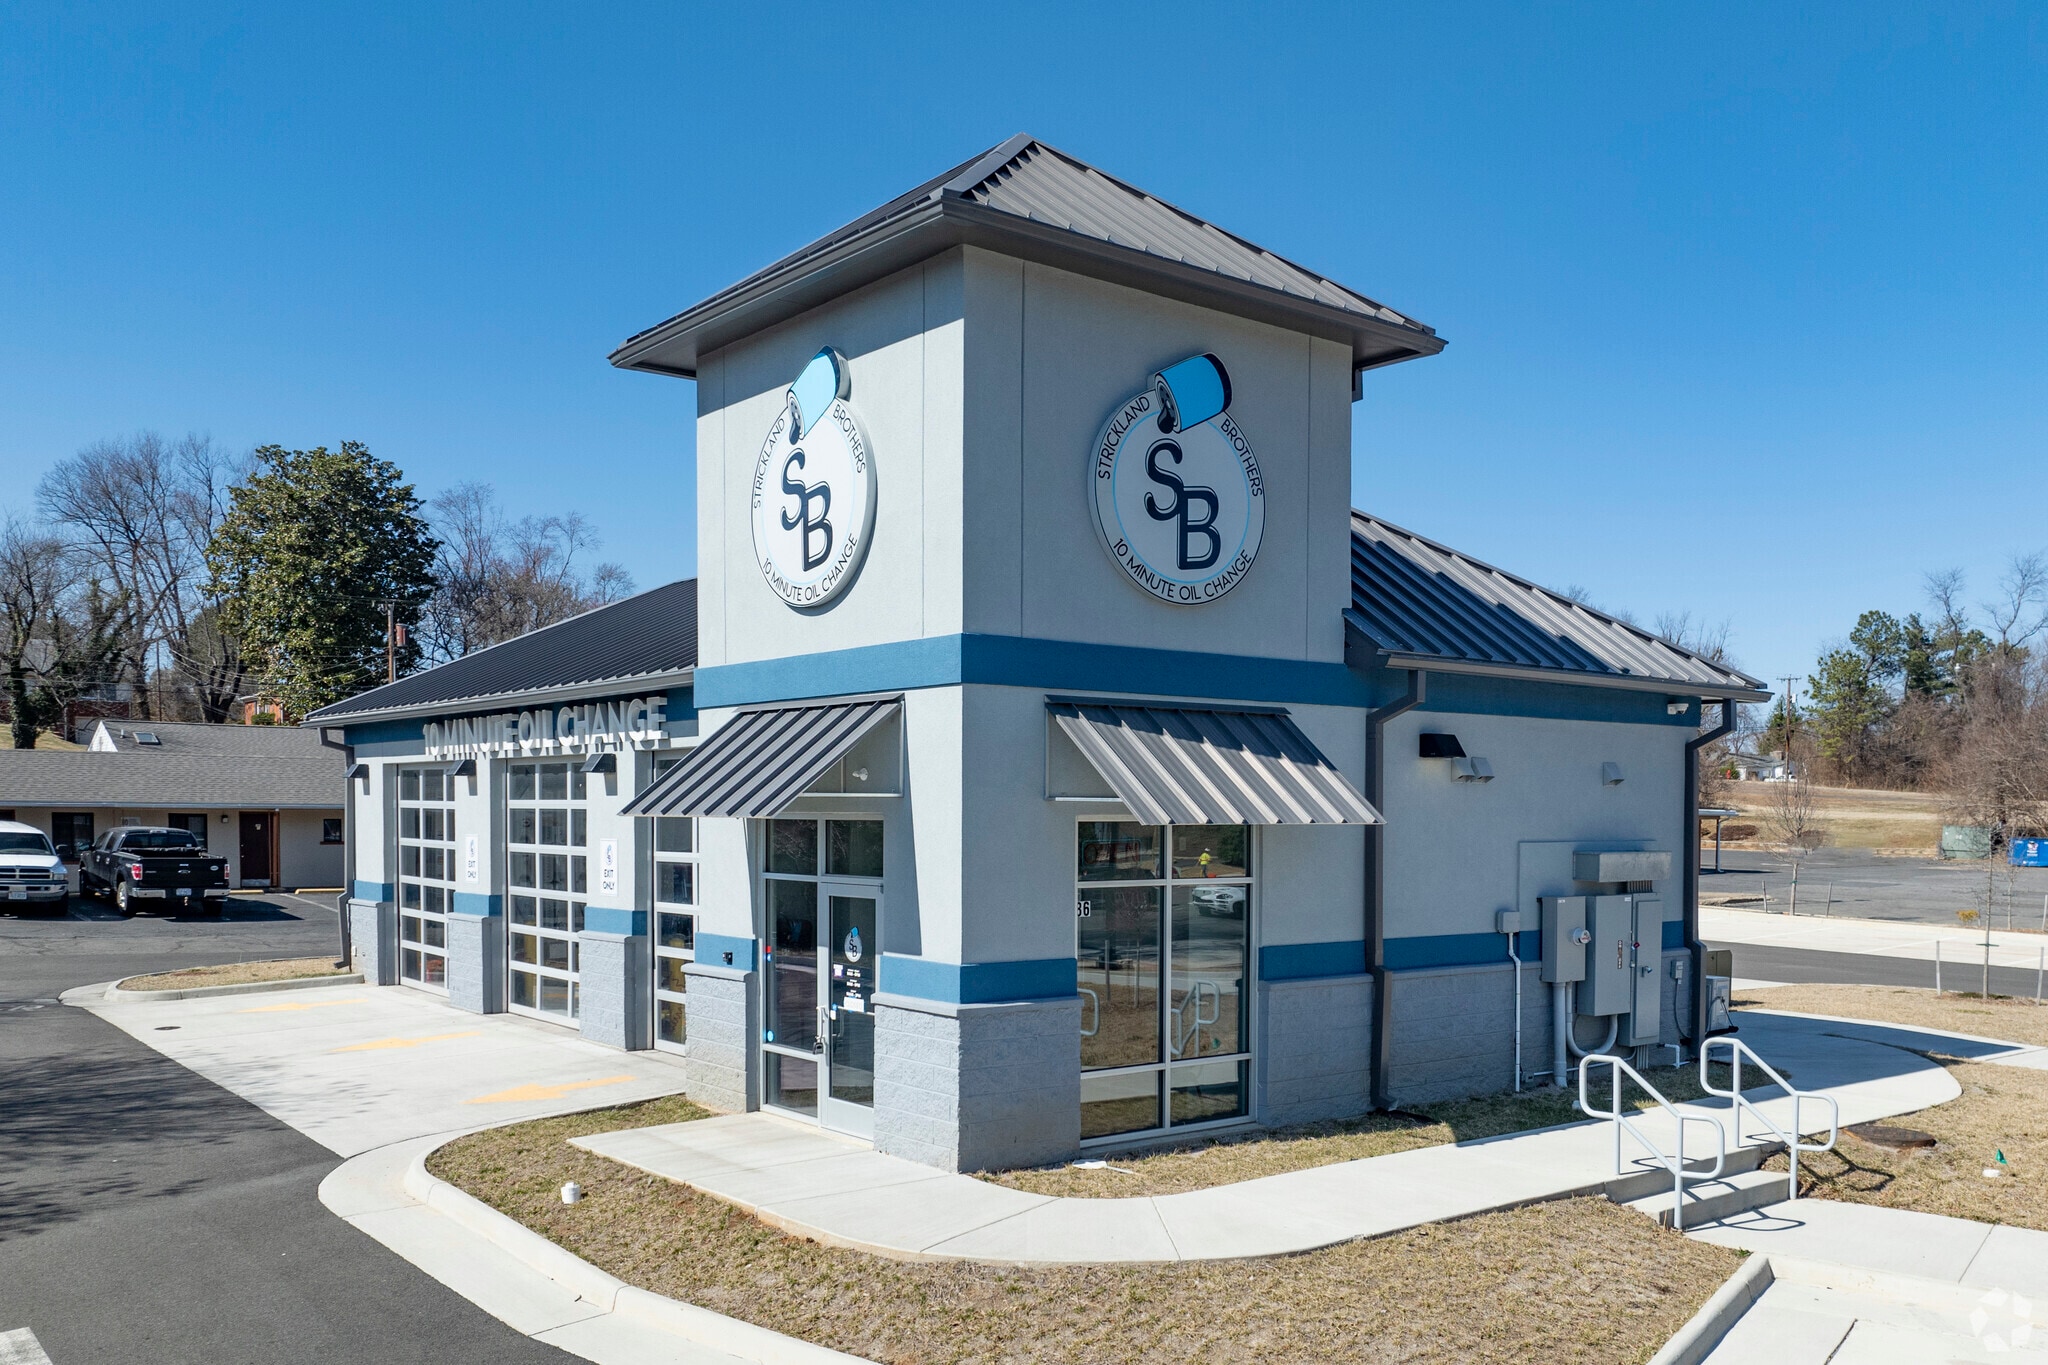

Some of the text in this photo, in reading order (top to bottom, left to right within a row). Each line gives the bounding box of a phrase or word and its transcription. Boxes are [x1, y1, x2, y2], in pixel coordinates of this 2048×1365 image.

[754, 418, 785, 509] STRICKLAND
[833, 404, 866, 474] BROTHERS
[1098, 396, 1150, 480] STRICKLAND
[1221, 418, 1263, 497] BROTHERS
[763, 533, 858, 602] 10 MINUTE OIL CHANGE
[1112, 538, 1252, 601] 10 MINUTE OIL CHANGE
[423, 696, 669, 756] 10 MINUTE OIL CHANGE
